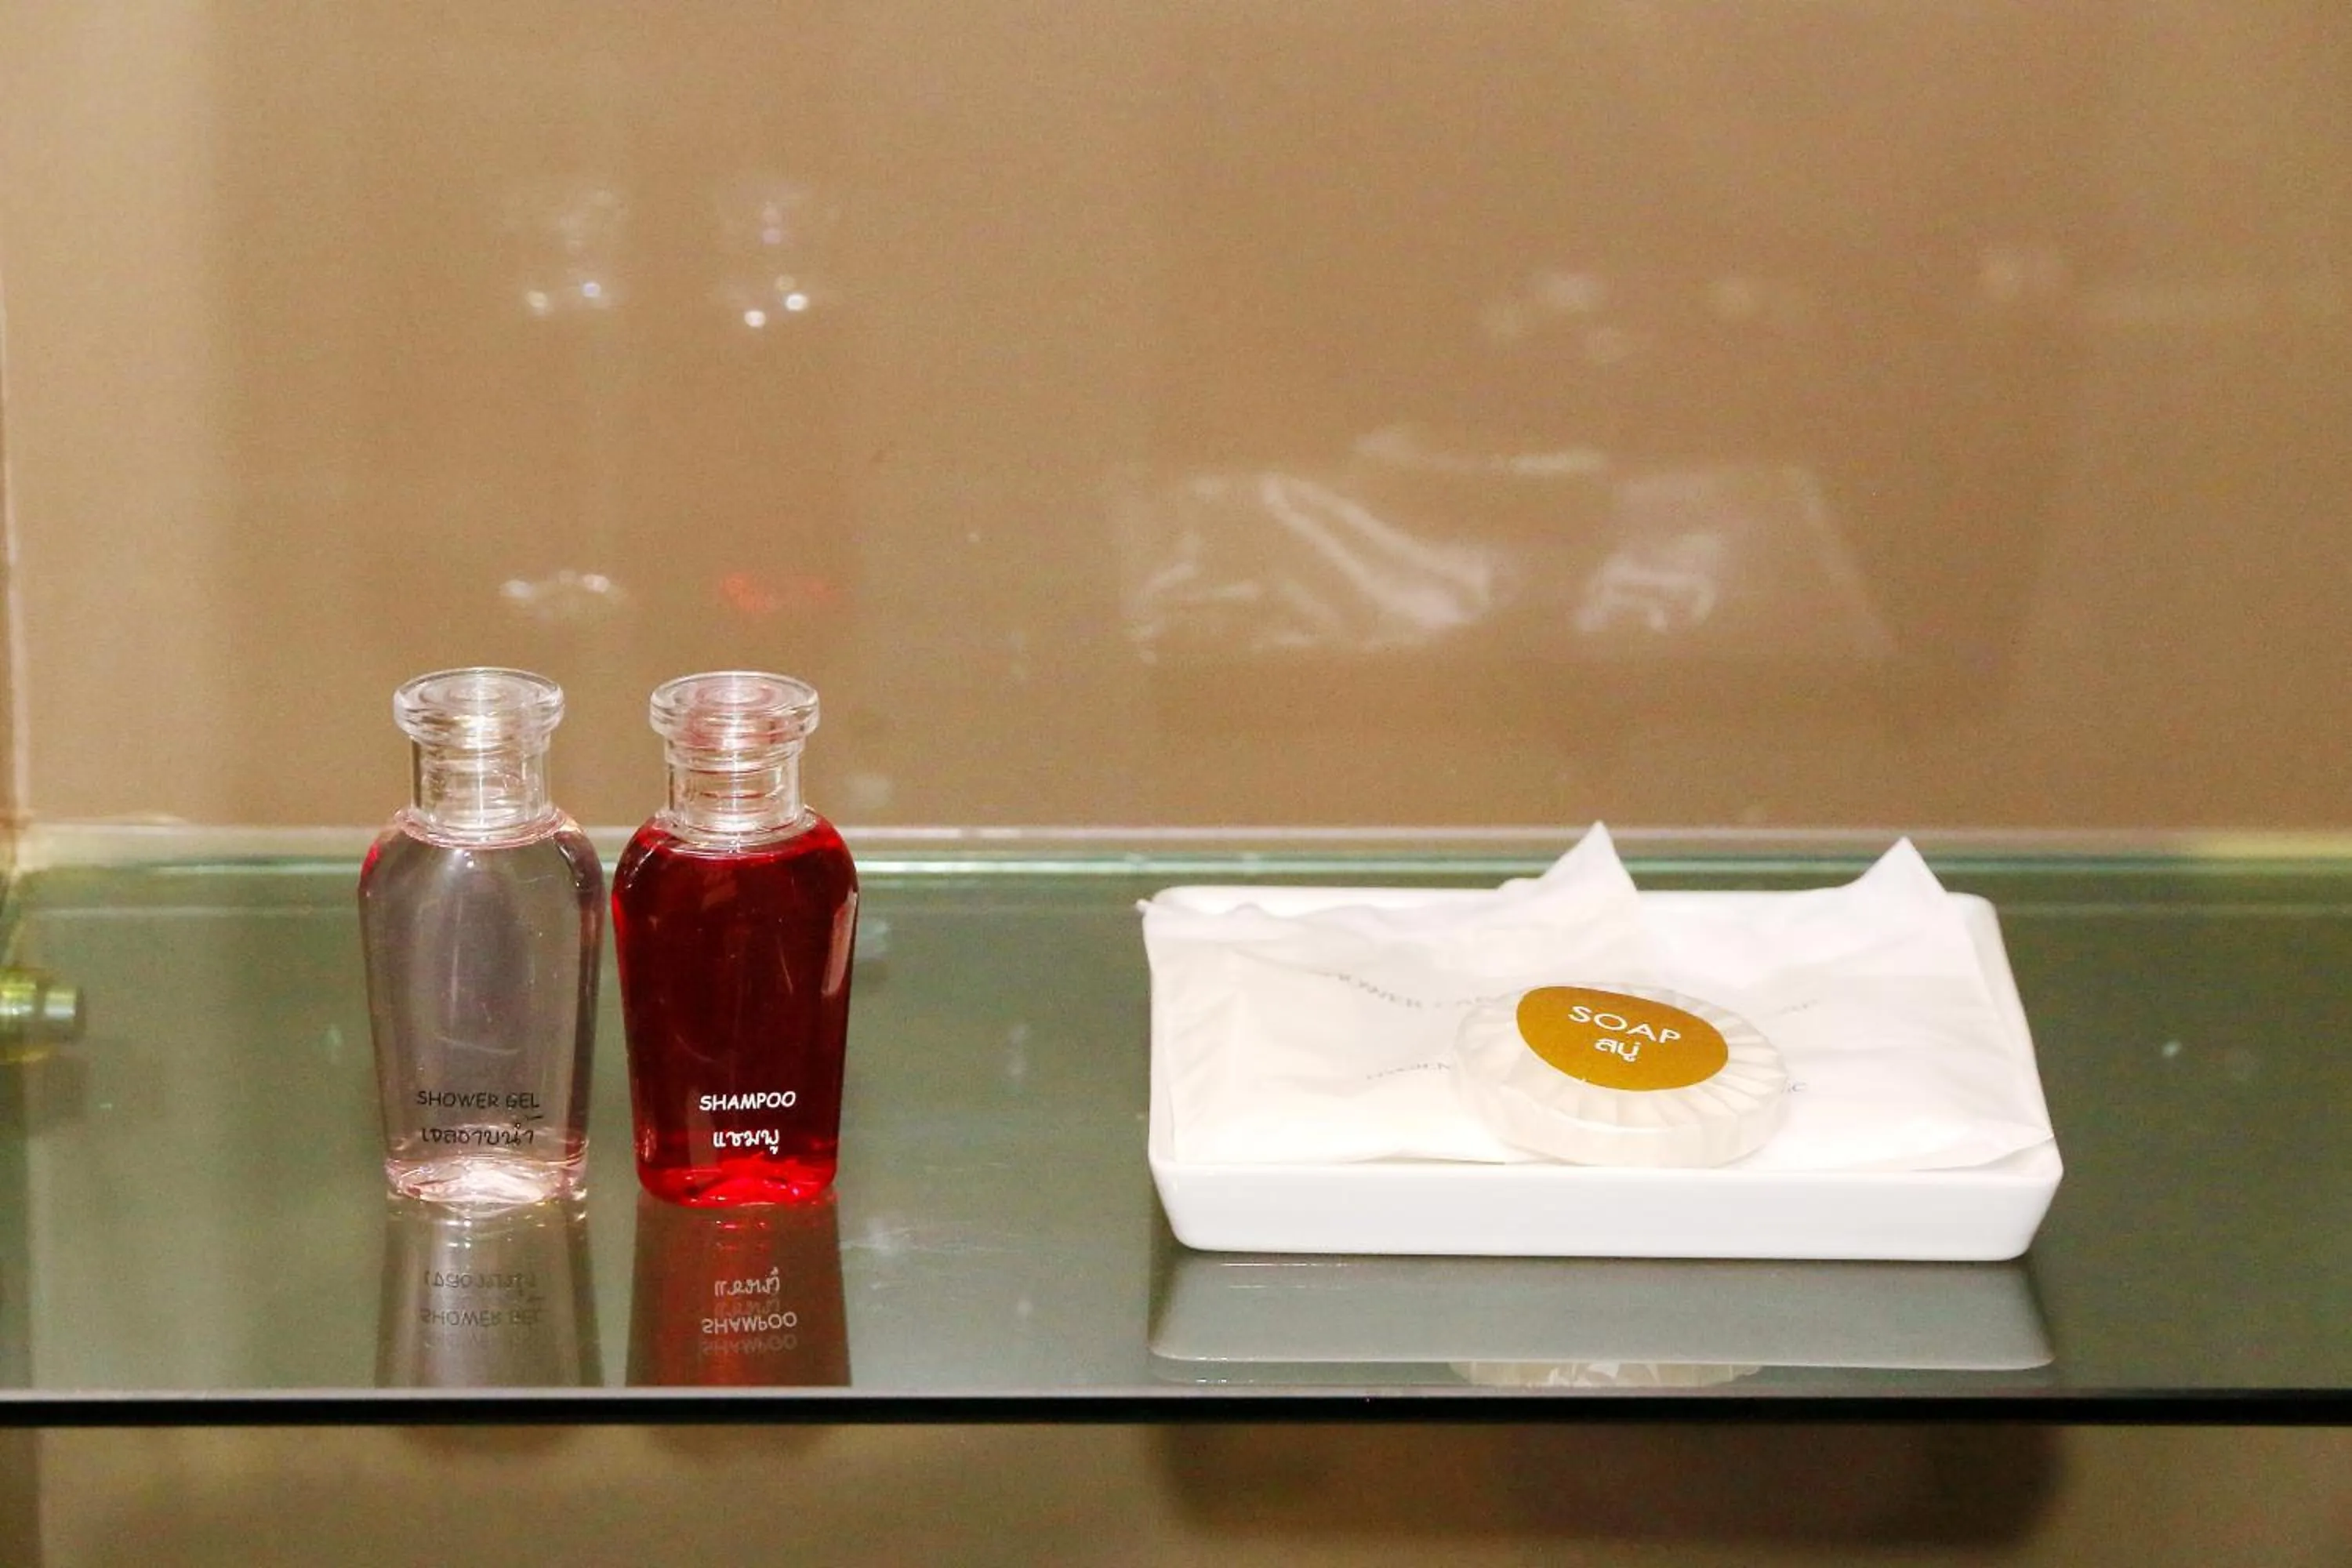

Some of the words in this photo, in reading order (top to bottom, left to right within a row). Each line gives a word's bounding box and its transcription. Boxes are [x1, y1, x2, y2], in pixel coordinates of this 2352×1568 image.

[1568, 1005, 1682, 1044] SOAP
[416, 1091, 499, 1109] SHOWER
[506, 1092, 540, 1109] GEL
[699, 1091, 797, 1111] SHAMPOO
[422, 1115, 543, 1146] เจลอาบน้ำ
[713, 1129, 780, 1155] แชมพู
